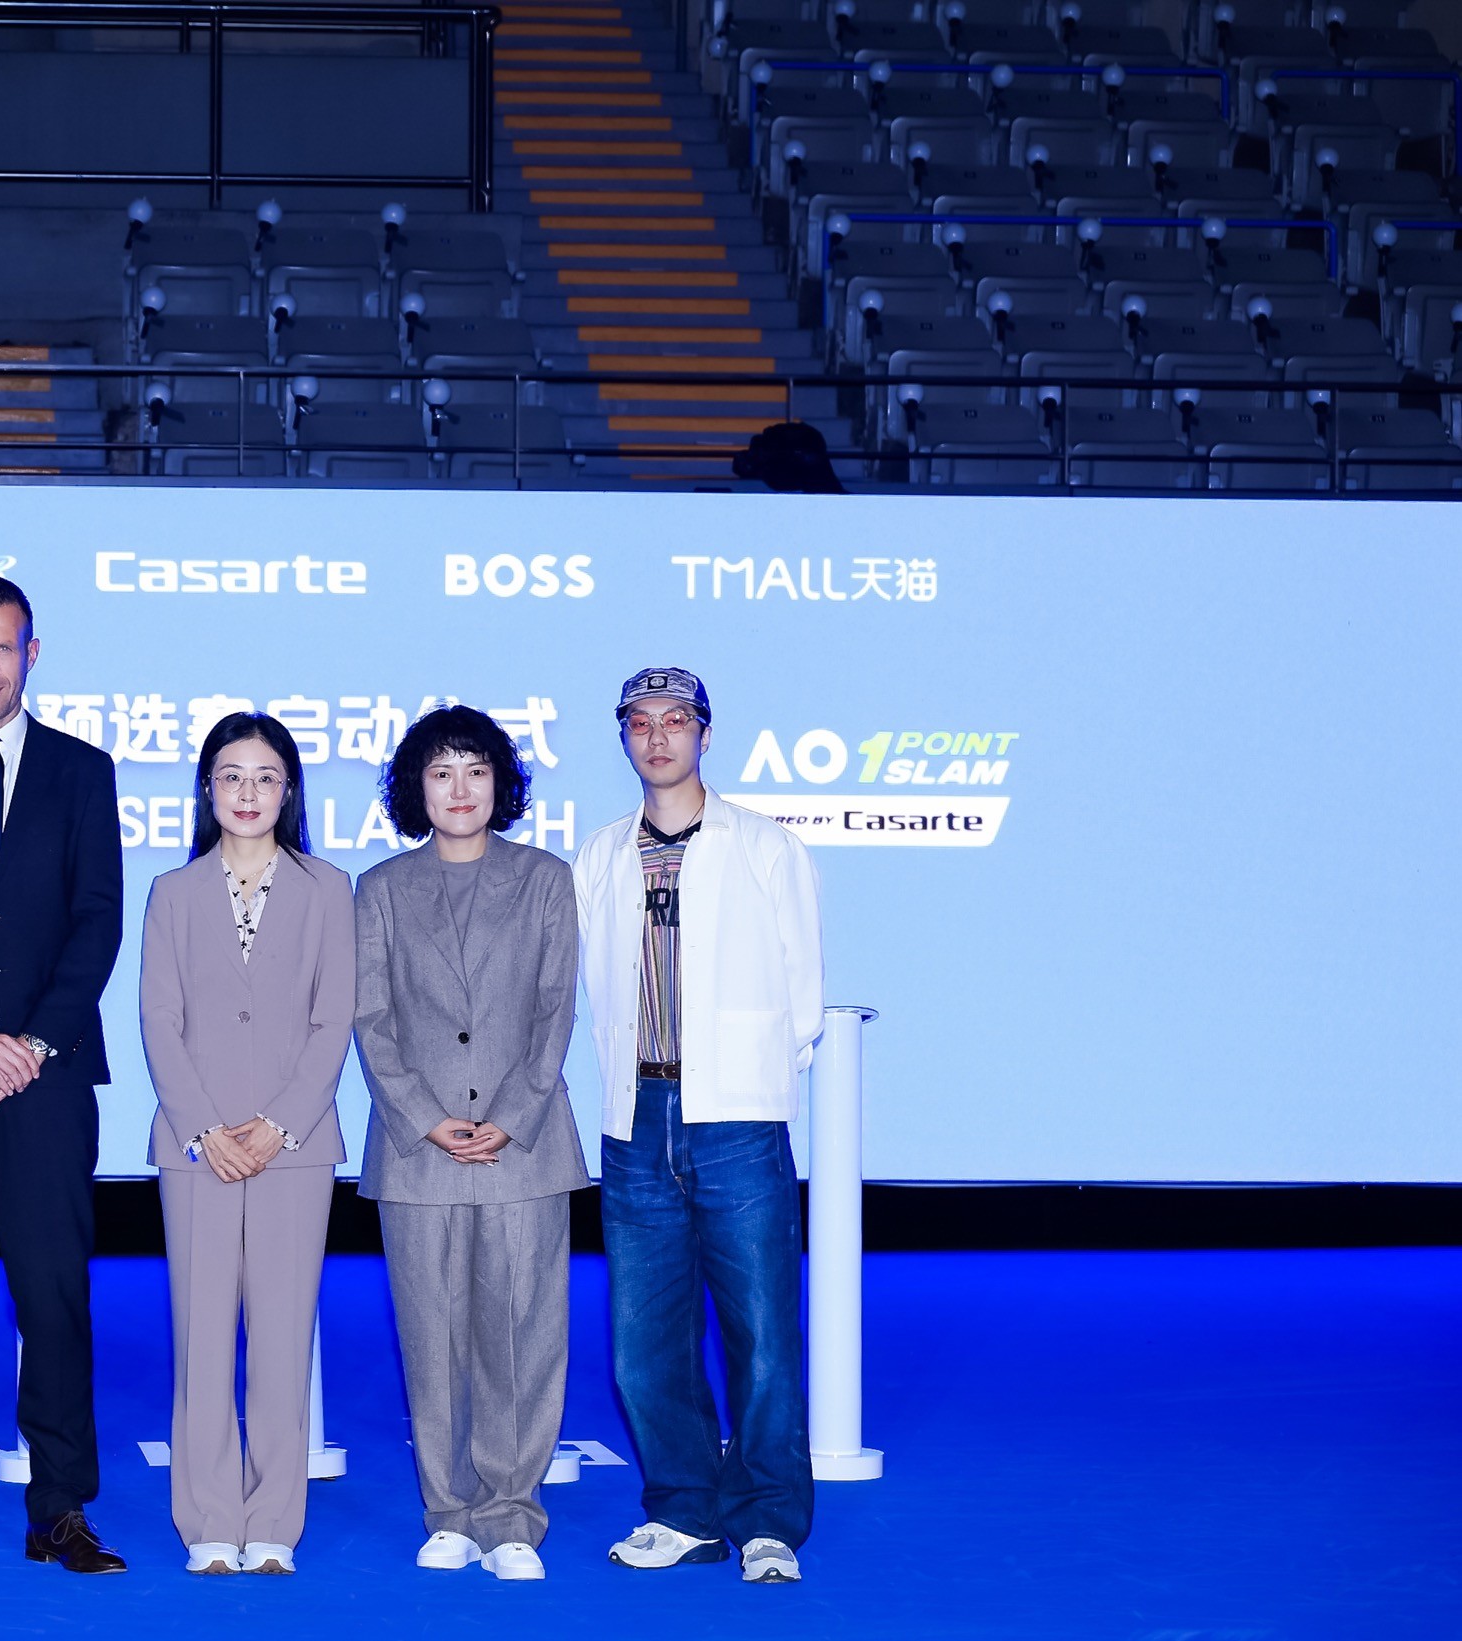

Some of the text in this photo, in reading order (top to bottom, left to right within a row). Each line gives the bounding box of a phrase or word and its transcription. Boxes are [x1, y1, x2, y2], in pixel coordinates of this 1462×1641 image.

[95, 551, 367, 595] Casarte
[444, 553, 595, 598] BOSS
[739, 728, 1020, 785] AO 1 POINT
[883, 758, 1010, 786] SLAM
[812, 816, 835, 825] BY
[843, 811, 984, 831] Casarte
